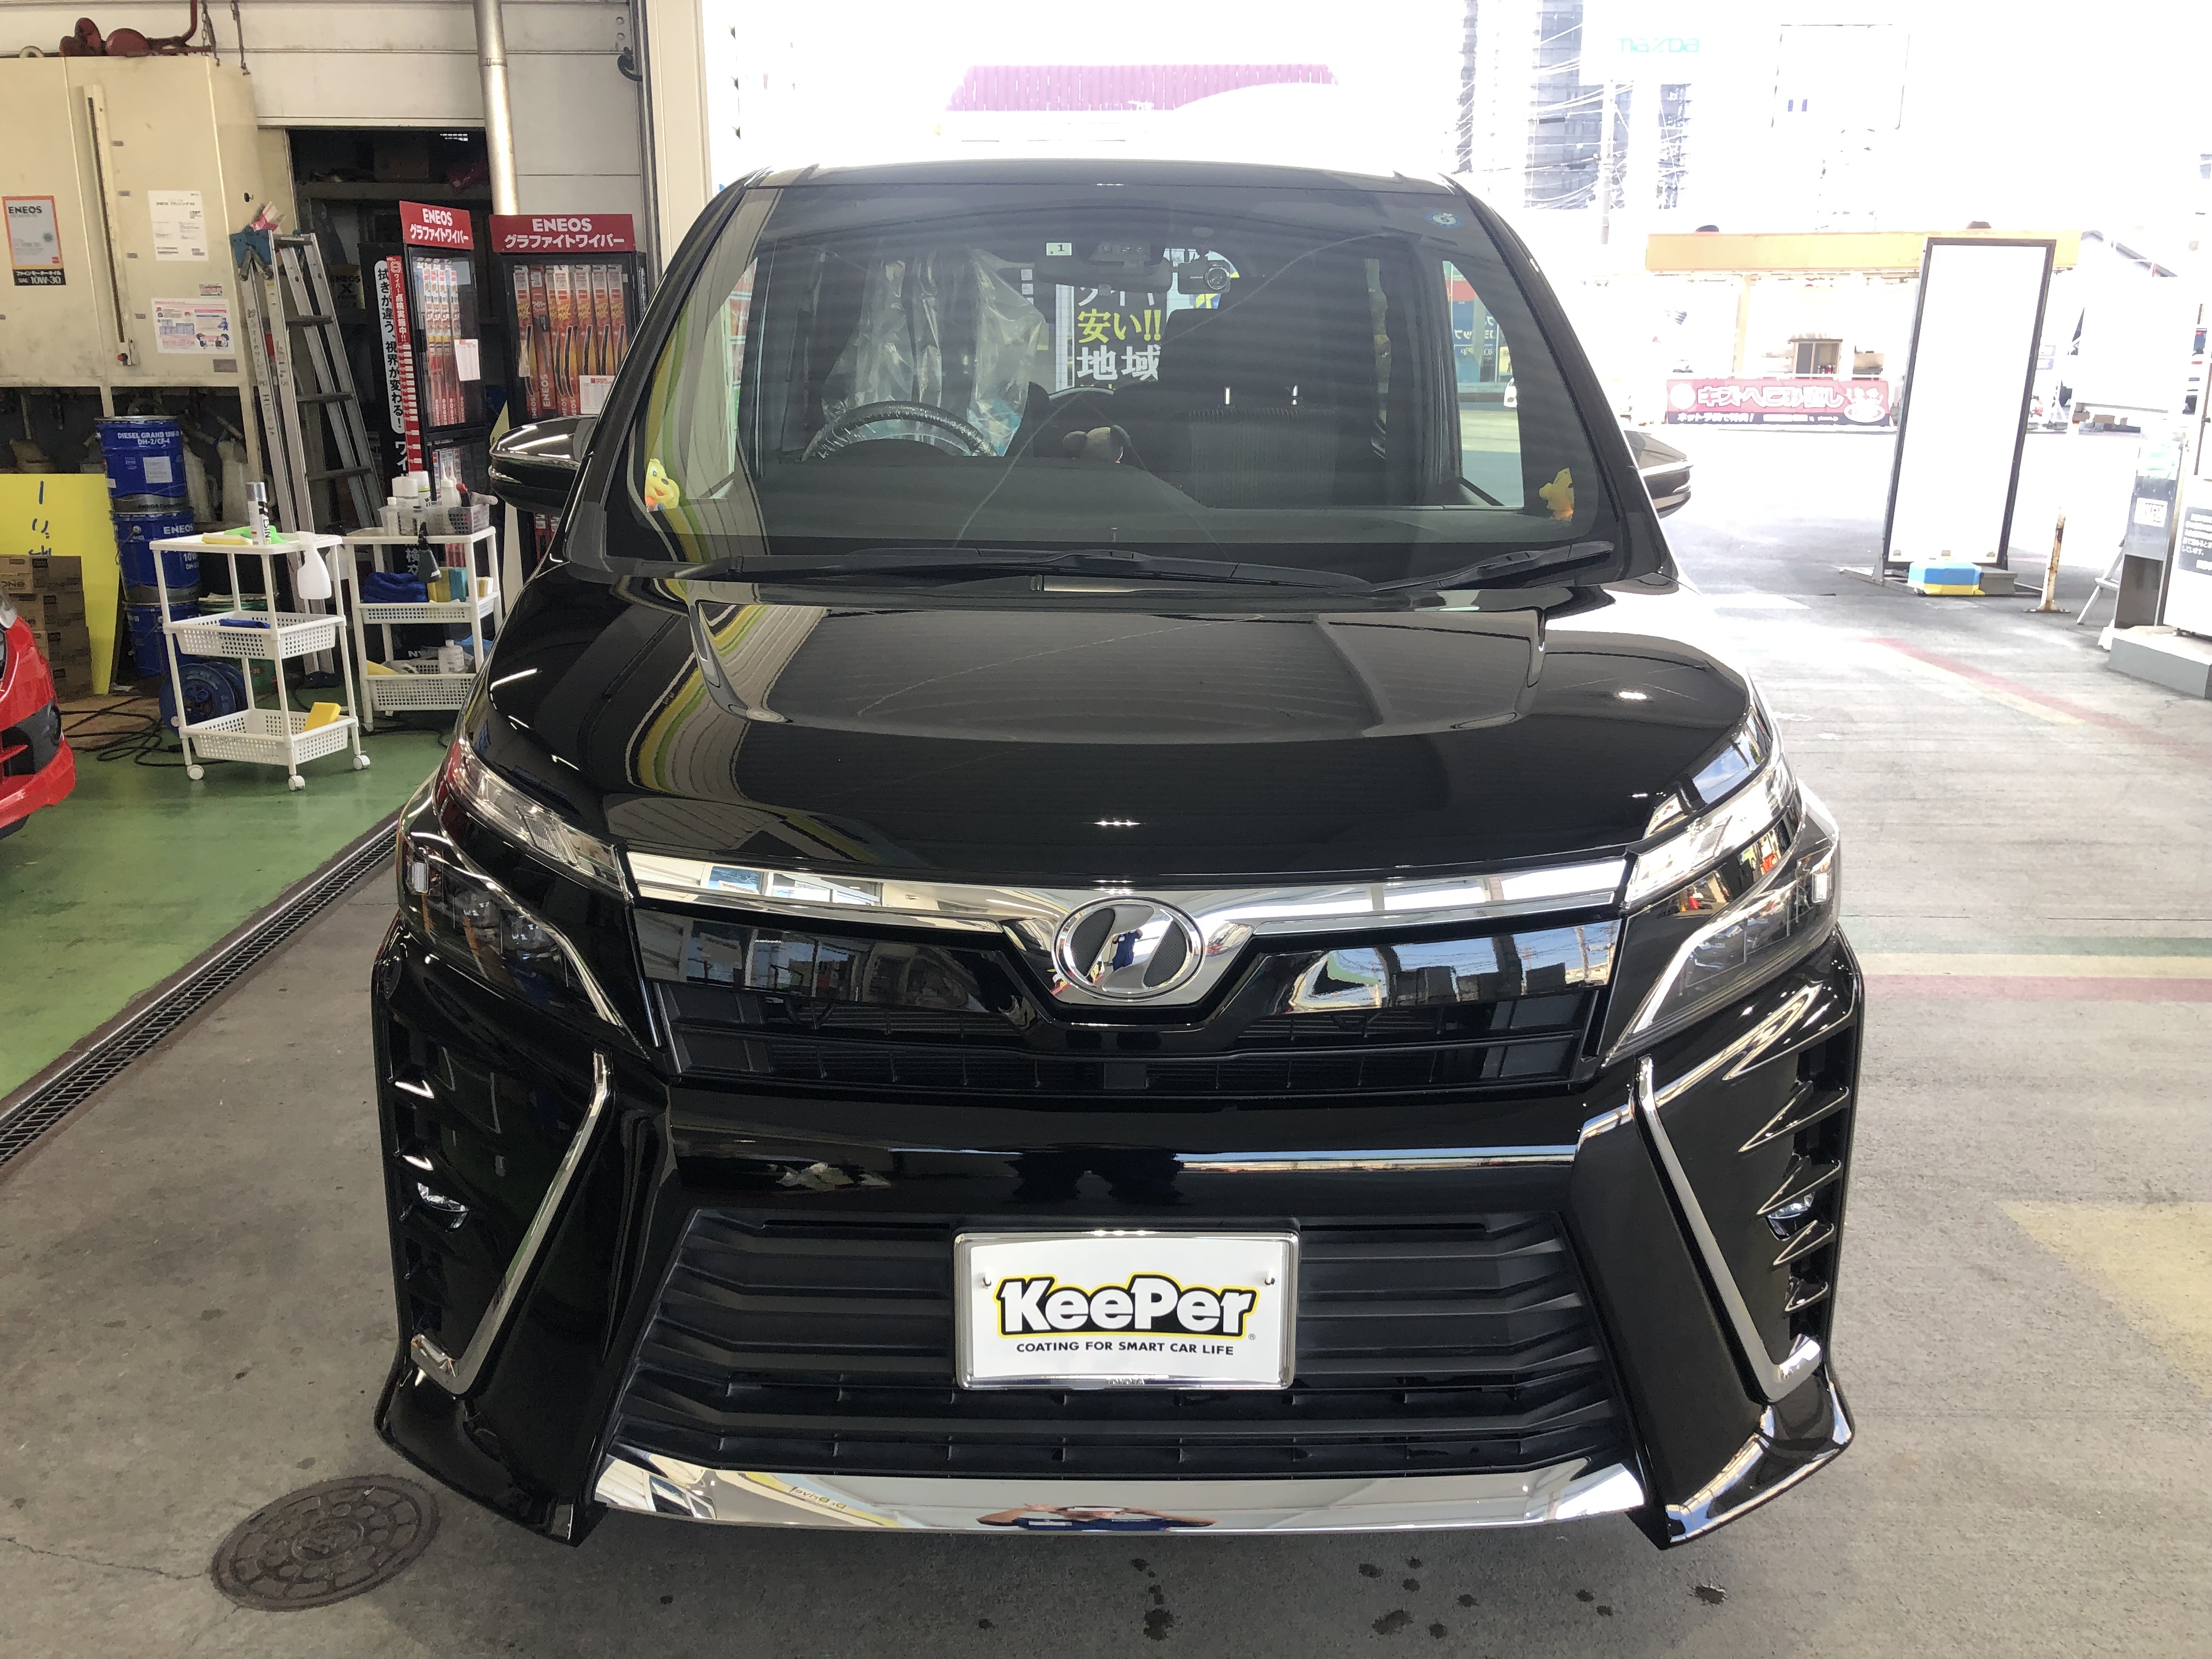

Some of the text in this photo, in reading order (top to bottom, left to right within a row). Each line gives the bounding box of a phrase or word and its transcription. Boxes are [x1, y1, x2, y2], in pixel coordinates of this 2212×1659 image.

[8, 205, 43, 215] ENEOS
[422, 207, 454, 227] ENEOS
[409, 223, 469, 245] グラファイトワイパー
[532, 217, 592, 233] ENEOS
[504, 233, 625, 249] グラファイトワイパー
[30, 276, 61, 284] 10W-30
[1077, 308, 1161, 343] 安い!!
[1076, 345, 1161, 381] 地域
[539, 374, 551, 407] ENEOS
[997, 1274, 1257, 1336] KeePer
[1016, 1341, 1234, 1356] COATING FOR SMART CAR LIFE
